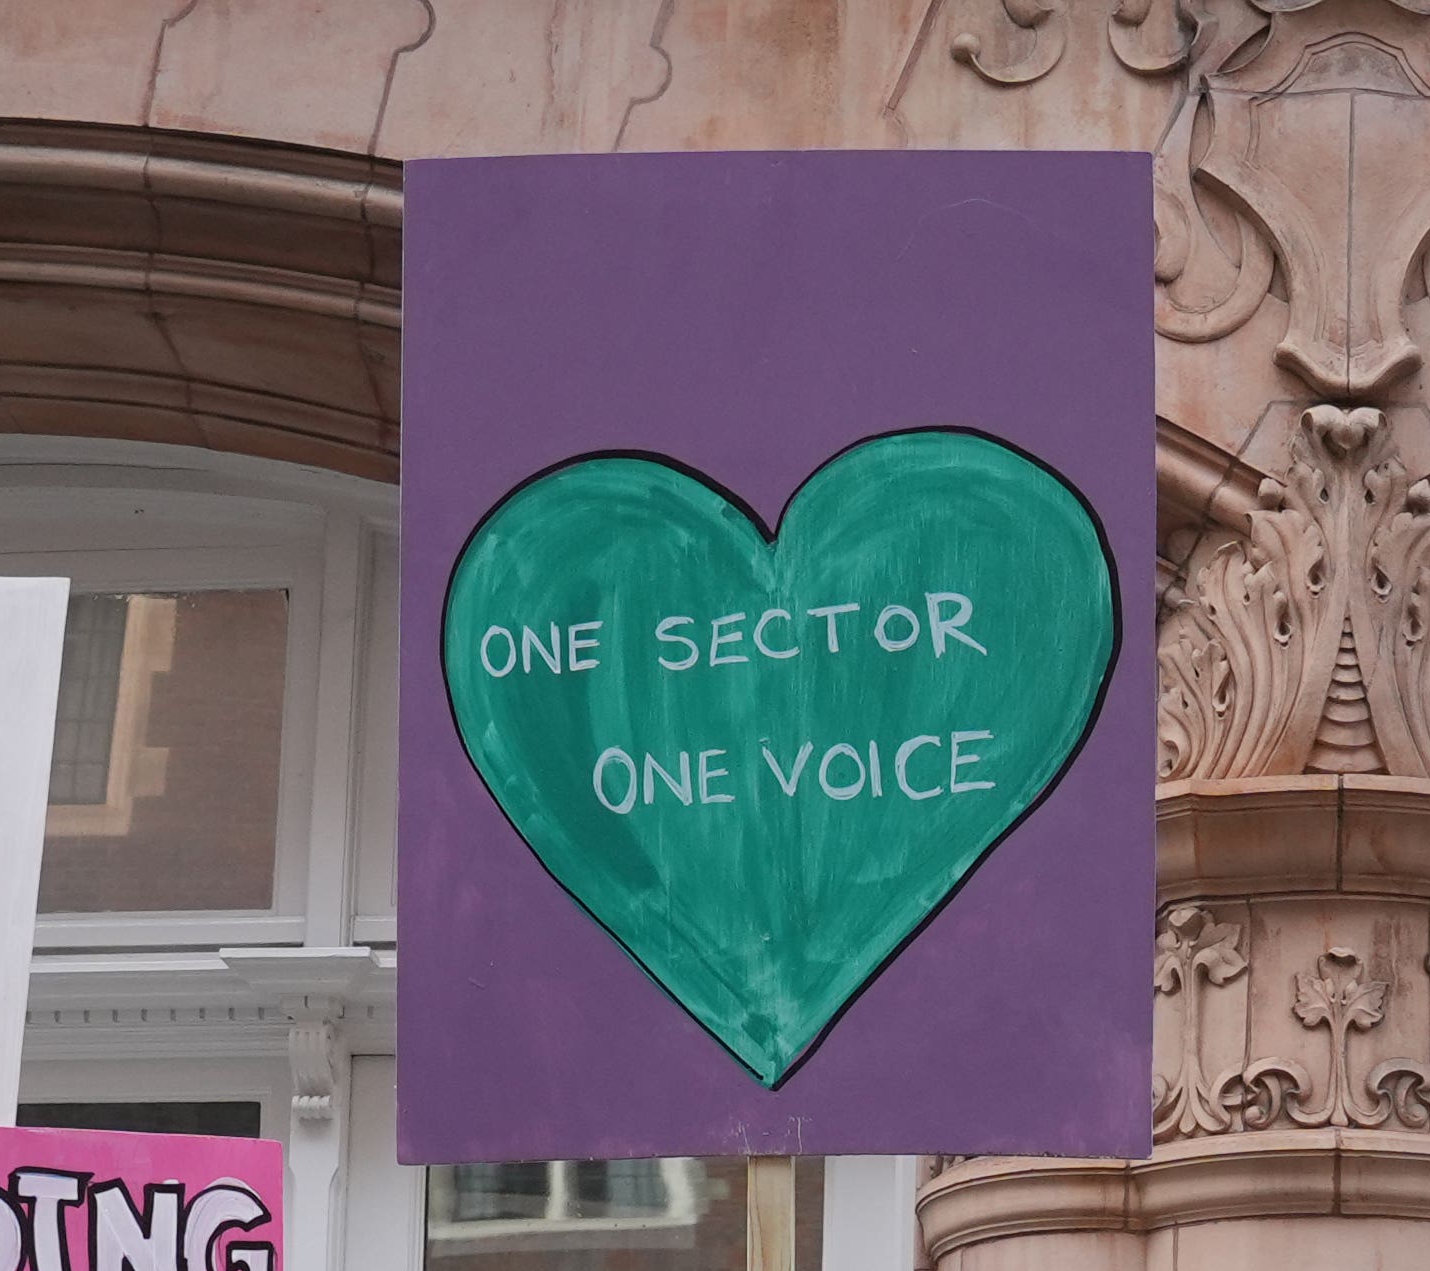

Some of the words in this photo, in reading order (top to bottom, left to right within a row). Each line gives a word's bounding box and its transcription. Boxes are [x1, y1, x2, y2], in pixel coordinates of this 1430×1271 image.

[479, 621, 602, 678] ONE
[654, 592, 988, 673] SECTOR
[592, 745, 735, 815] ONE
[763, 730, 996, 801] VOICE
